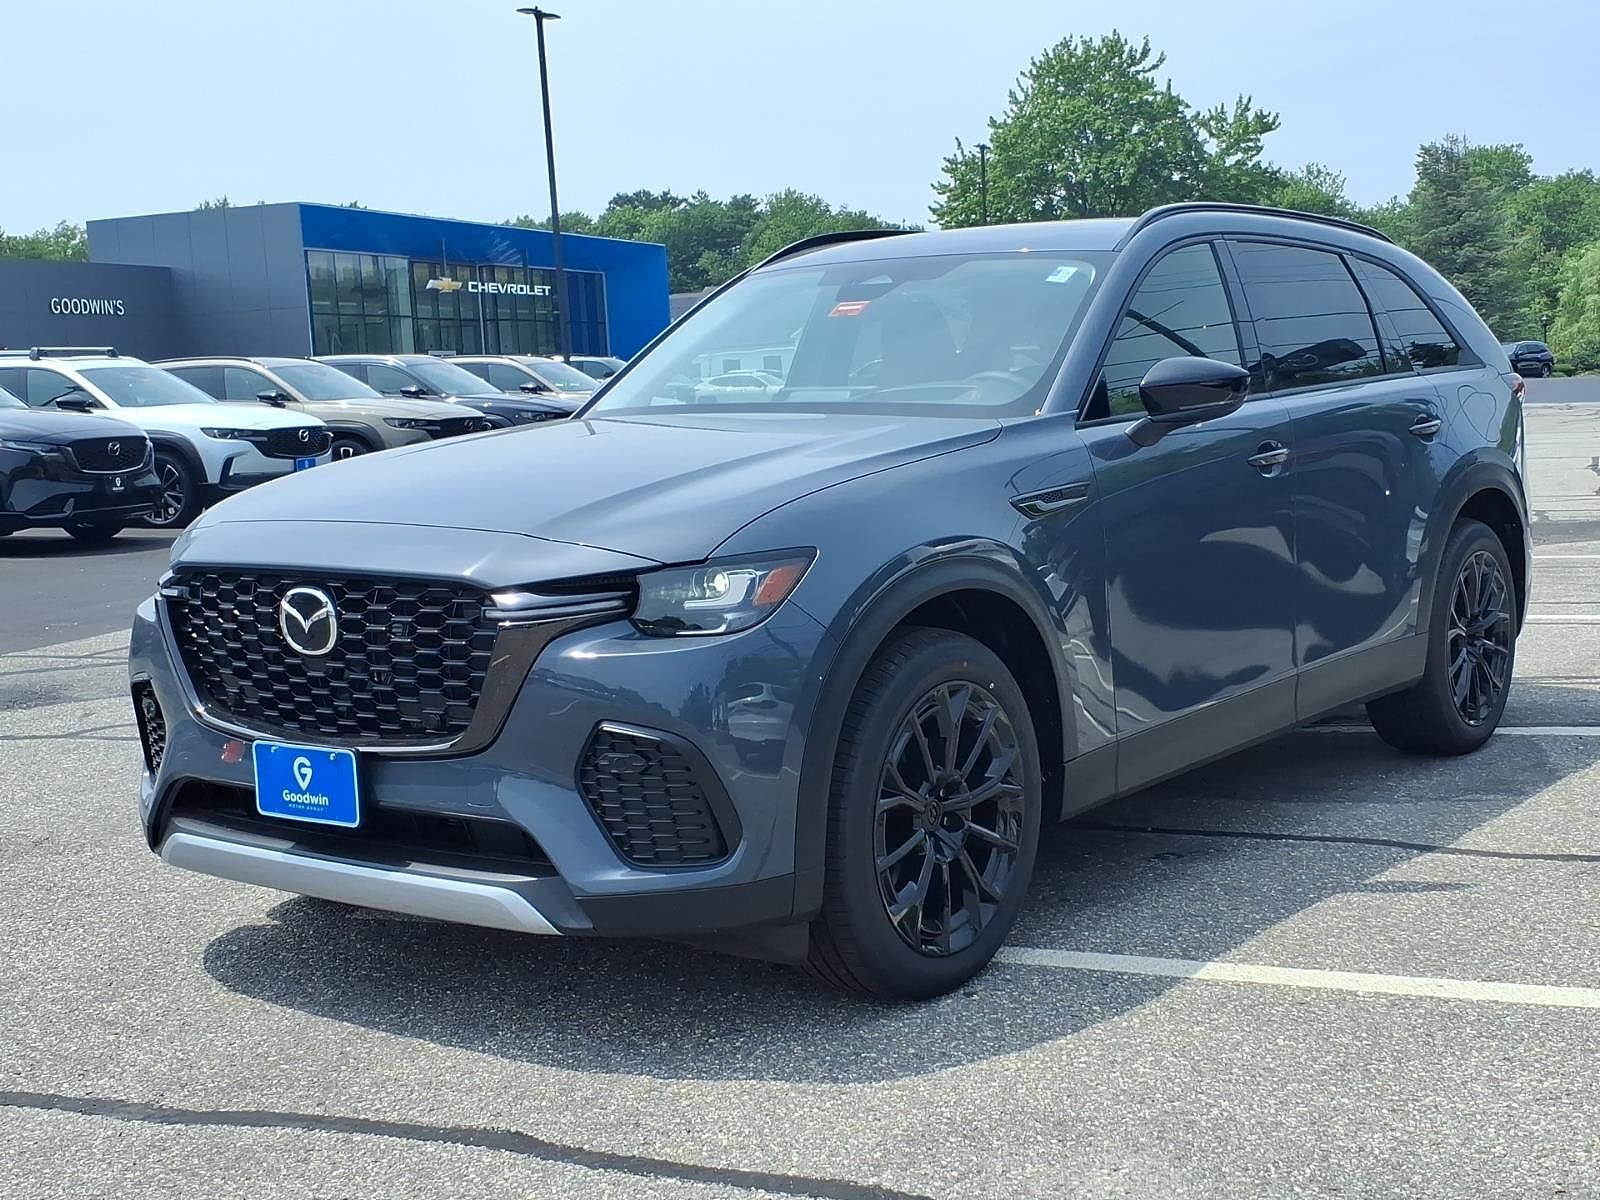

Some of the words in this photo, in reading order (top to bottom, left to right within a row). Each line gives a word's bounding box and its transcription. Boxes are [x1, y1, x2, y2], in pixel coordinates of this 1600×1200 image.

[468, 281, 551, 296] CHEVROLET
[51, 298, 125, 315] GOODWIN'S
[282, 789, 329, 806] Goodwin
